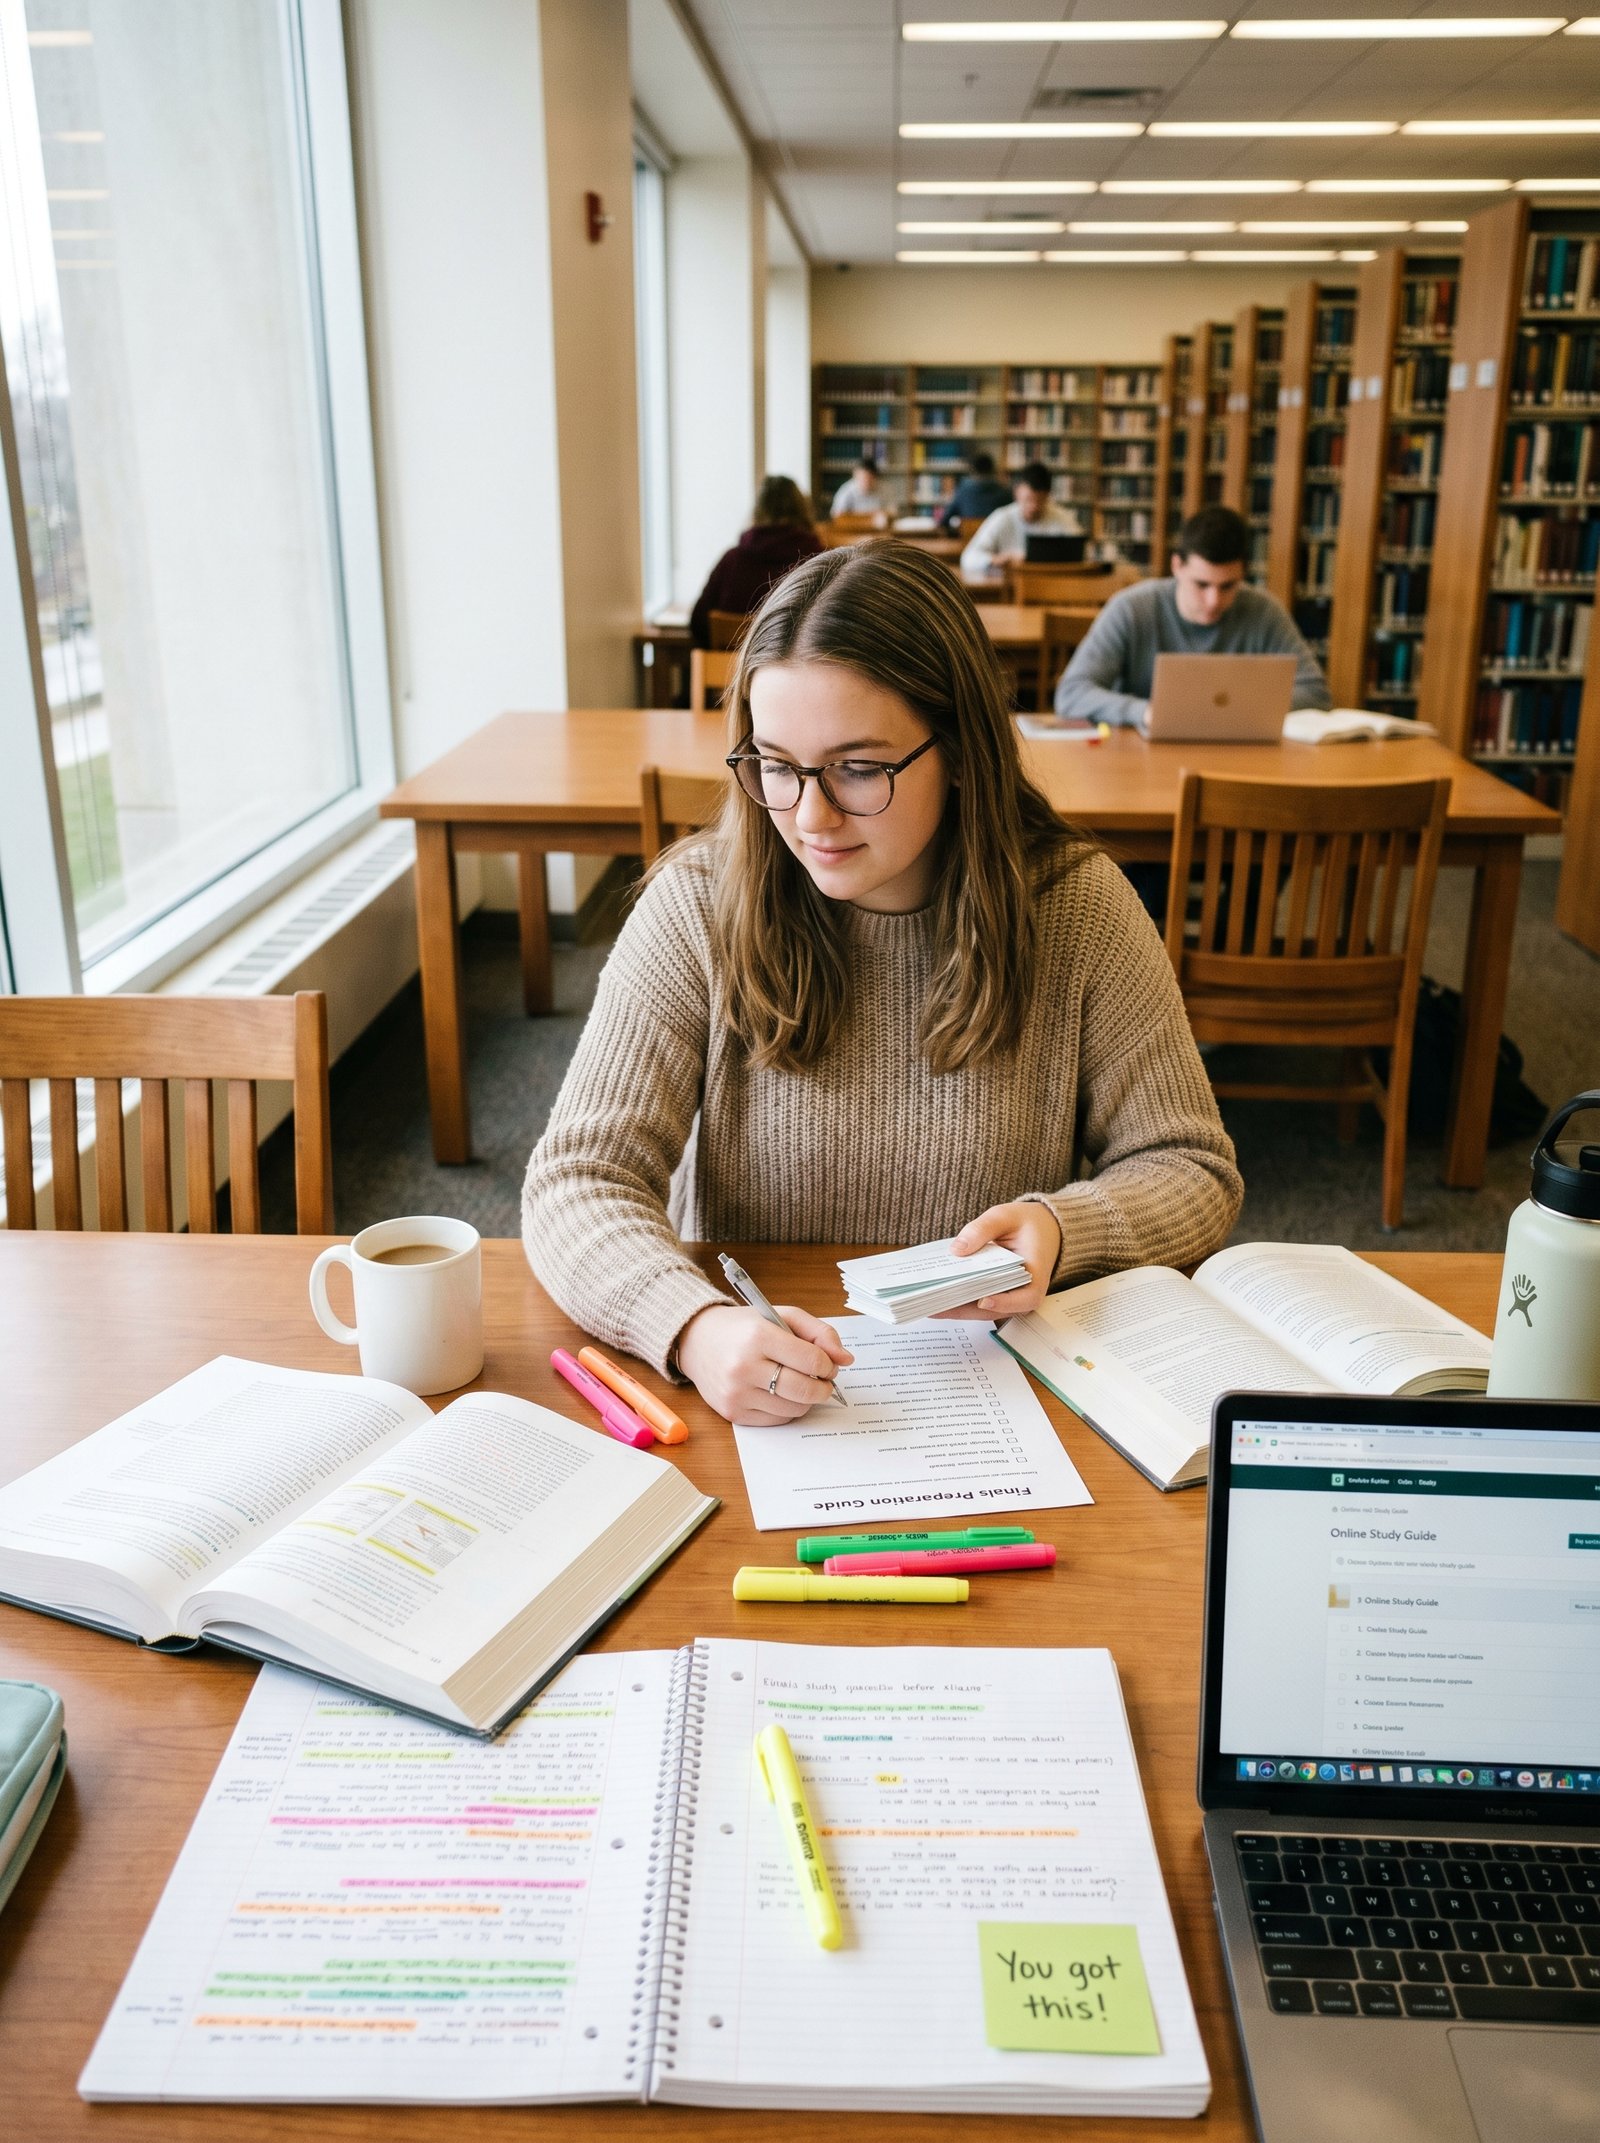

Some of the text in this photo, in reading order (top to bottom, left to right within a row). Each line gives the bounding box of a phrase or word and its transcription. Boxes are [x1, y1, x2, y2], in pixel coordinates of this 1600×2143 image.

[813, 1486, 1032, 1511] Finals Preparation Guide
[1330, 1528, 1437, 1541] Online Study Guide
[1364, 1597, 1390, 1605] Online
[1392, 1597, 1414, 1607] Study
[1416, 1598, 1439, 1606] Guide
[1341, 1870, 1349, 1880] 2
[1381, 1872, 1390, 1881] 3
[1423, 1874, 1431, 1882] 4
[1545, 1878, 1552, 1887] 7
[1325, 1895, 1335, 1905] Q
[1366, 1896, 1377, 1906] W
[1409, 1898, 1418, 1907] E
[1450, 1900, 1460, 1909] R
[1492, 1901, 1500, 1910] T
[1533, 1903, 1542, 1912] Y
[1574, 1904, 1585, 1914] U
[1345, 1927, 1354, 1936] A
[1387, 1928, 1396, 1938] S
[1429, 1930, 1439, 1940] D
[1471, 1931, 1479, 1940] F
[1513, 1933, 1523, 1943] G
[1555, 1934, 1566, 1943] H
[1375, 1960, 1384, 1970] Z
[1417, 1962, 1428, 1971] X
[1461, 1963, 1471, 1973] C
[1503, 1965, 1513, 1975] V
[996, 1950, 1121, 1991] You got
[1546, 1966, 1557, 1976] B
[1589, 1968, 1600, 1977] N
[1023, 1992, 1108, 2023] this!
